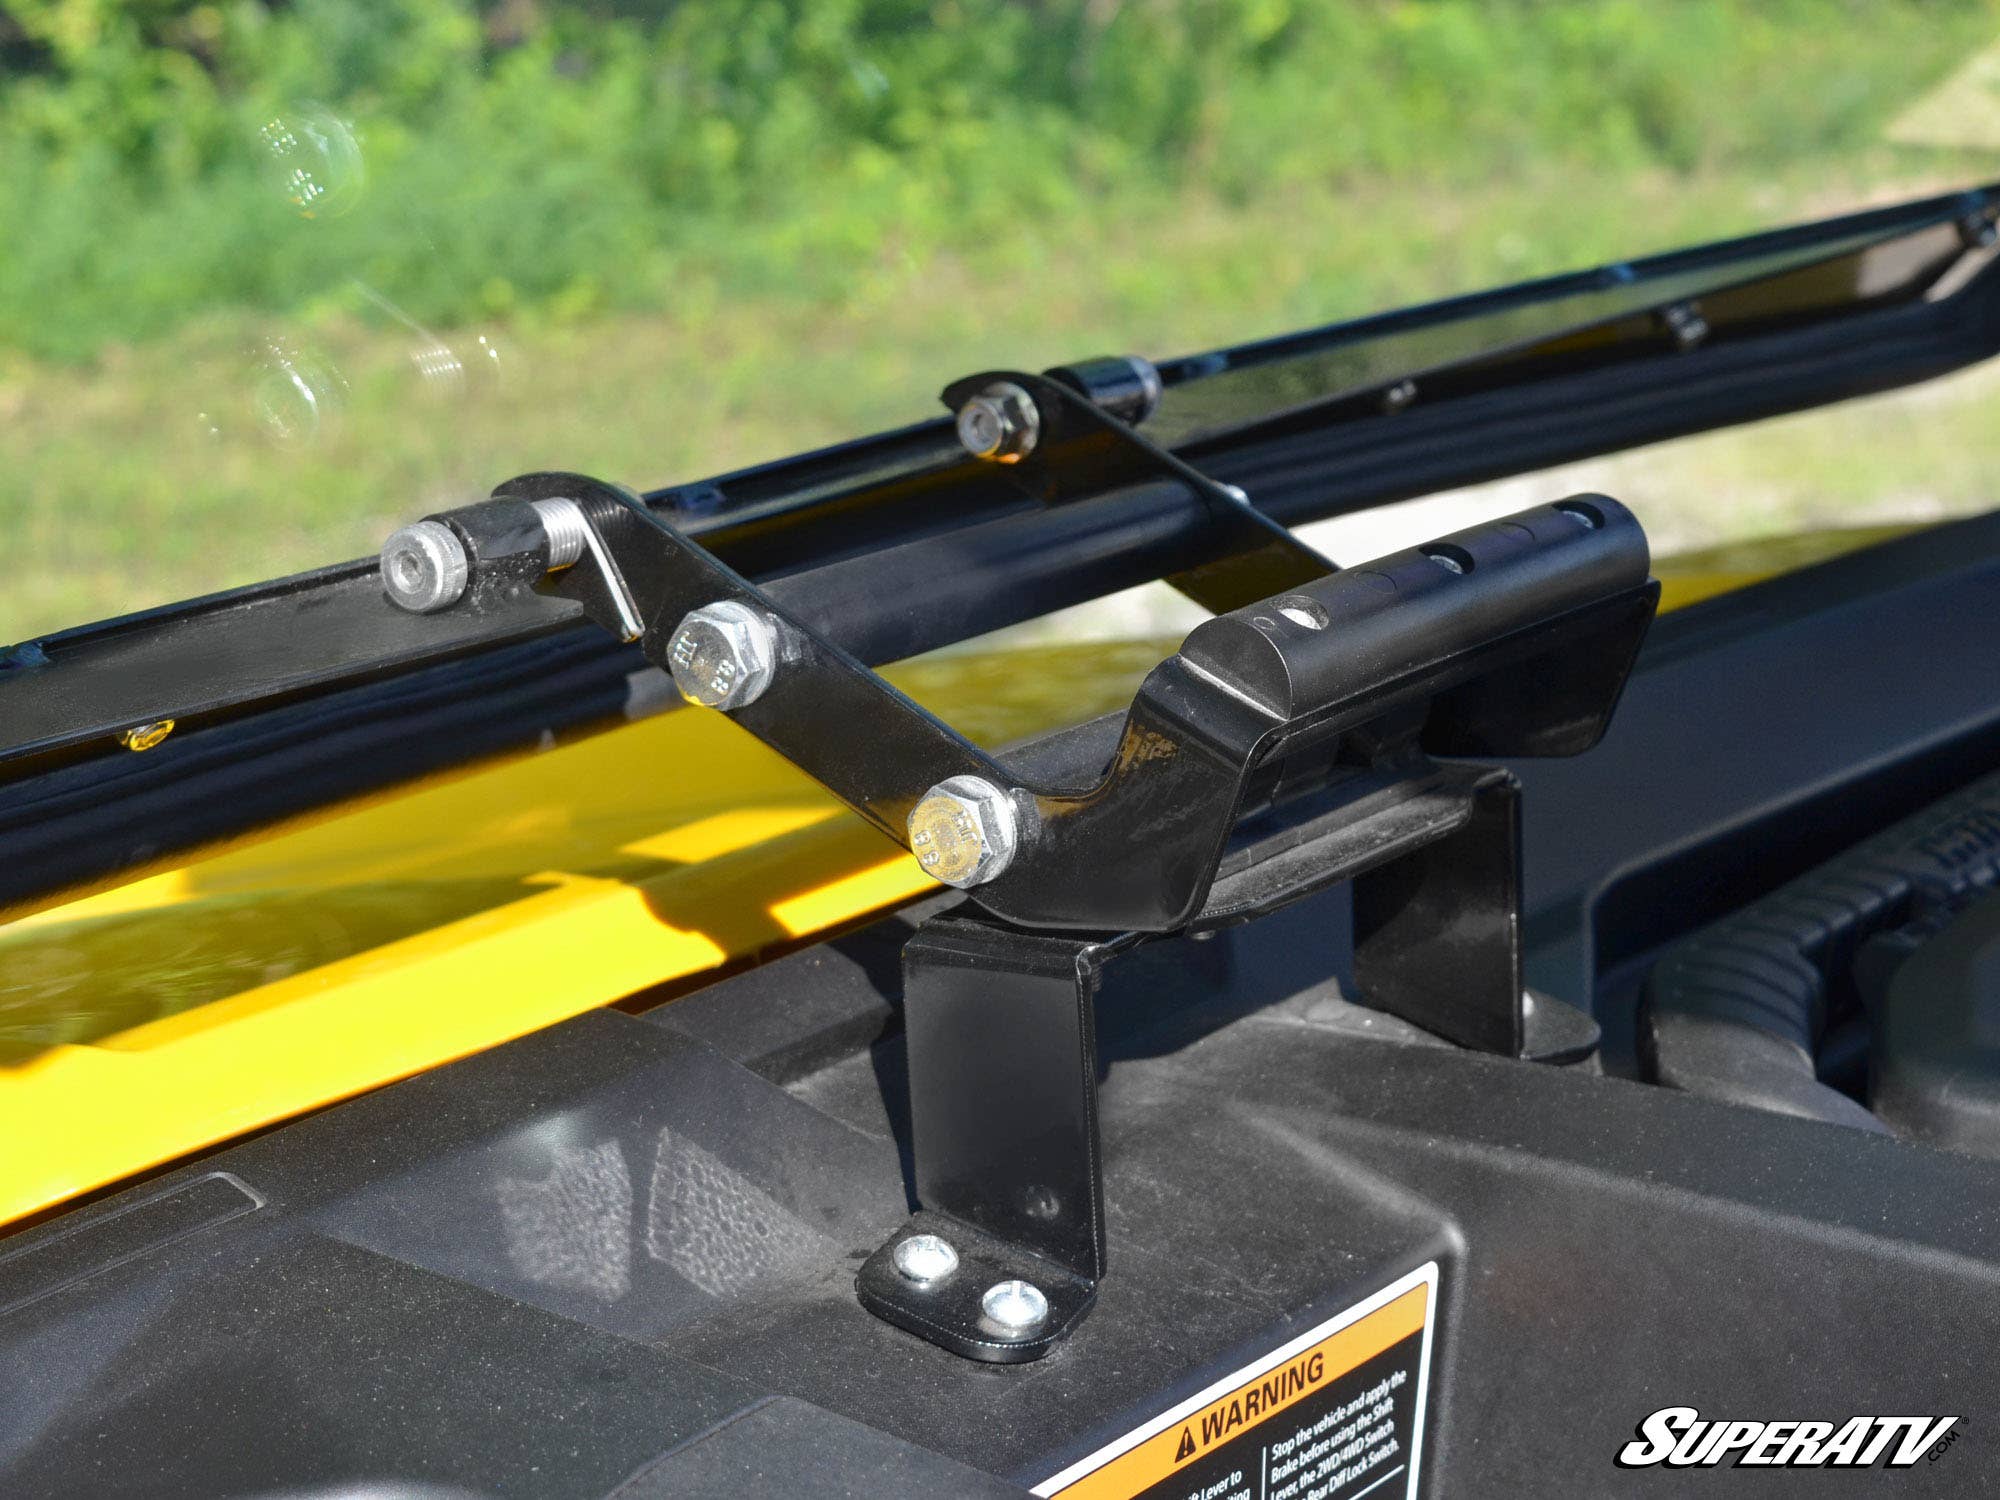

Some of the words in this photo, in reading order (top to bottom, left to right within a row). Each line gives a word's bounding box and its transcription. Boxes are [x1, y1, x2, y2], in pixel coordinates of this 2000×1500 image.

[1201, 1352, 1325, 1446] WARNING
[1272, 1438, 1295, 1460] Stop
[1296, 1427, 1312, 1446] the
[1313, 1406, 1346, 1436] vehicle
[1346, 1391, 1365, 1416] and
[1365, 1379, 1390, 1405] apply
[1390, 1370, 1407, 1389] the
[1271, 1458, 1298, 1484] Brake
[1299, 1439, 1330, 1468] before
[1330, 1423, 1356, 1448] using
[1357, 1413, 1372, 1432] the
[1373, 1396, 1394, 1421] Shift
[1299, 1470, 1316, 1489] the
[1317, 1437, 1365, 1479] 2WD/4WD
[1364, 1418, 1394, 1449] Switch
[1307, 1484, 1328, 1500] Rear
[1329, 1467, 1347, 1493] Diff
[1347, 1456, 1368, 1482] Lock
[1368, 1438, 1400, 1468] Switch.
[1201, 1477, 1229, 1500] Lever
[1230, 1470, 1242, 1486] to
